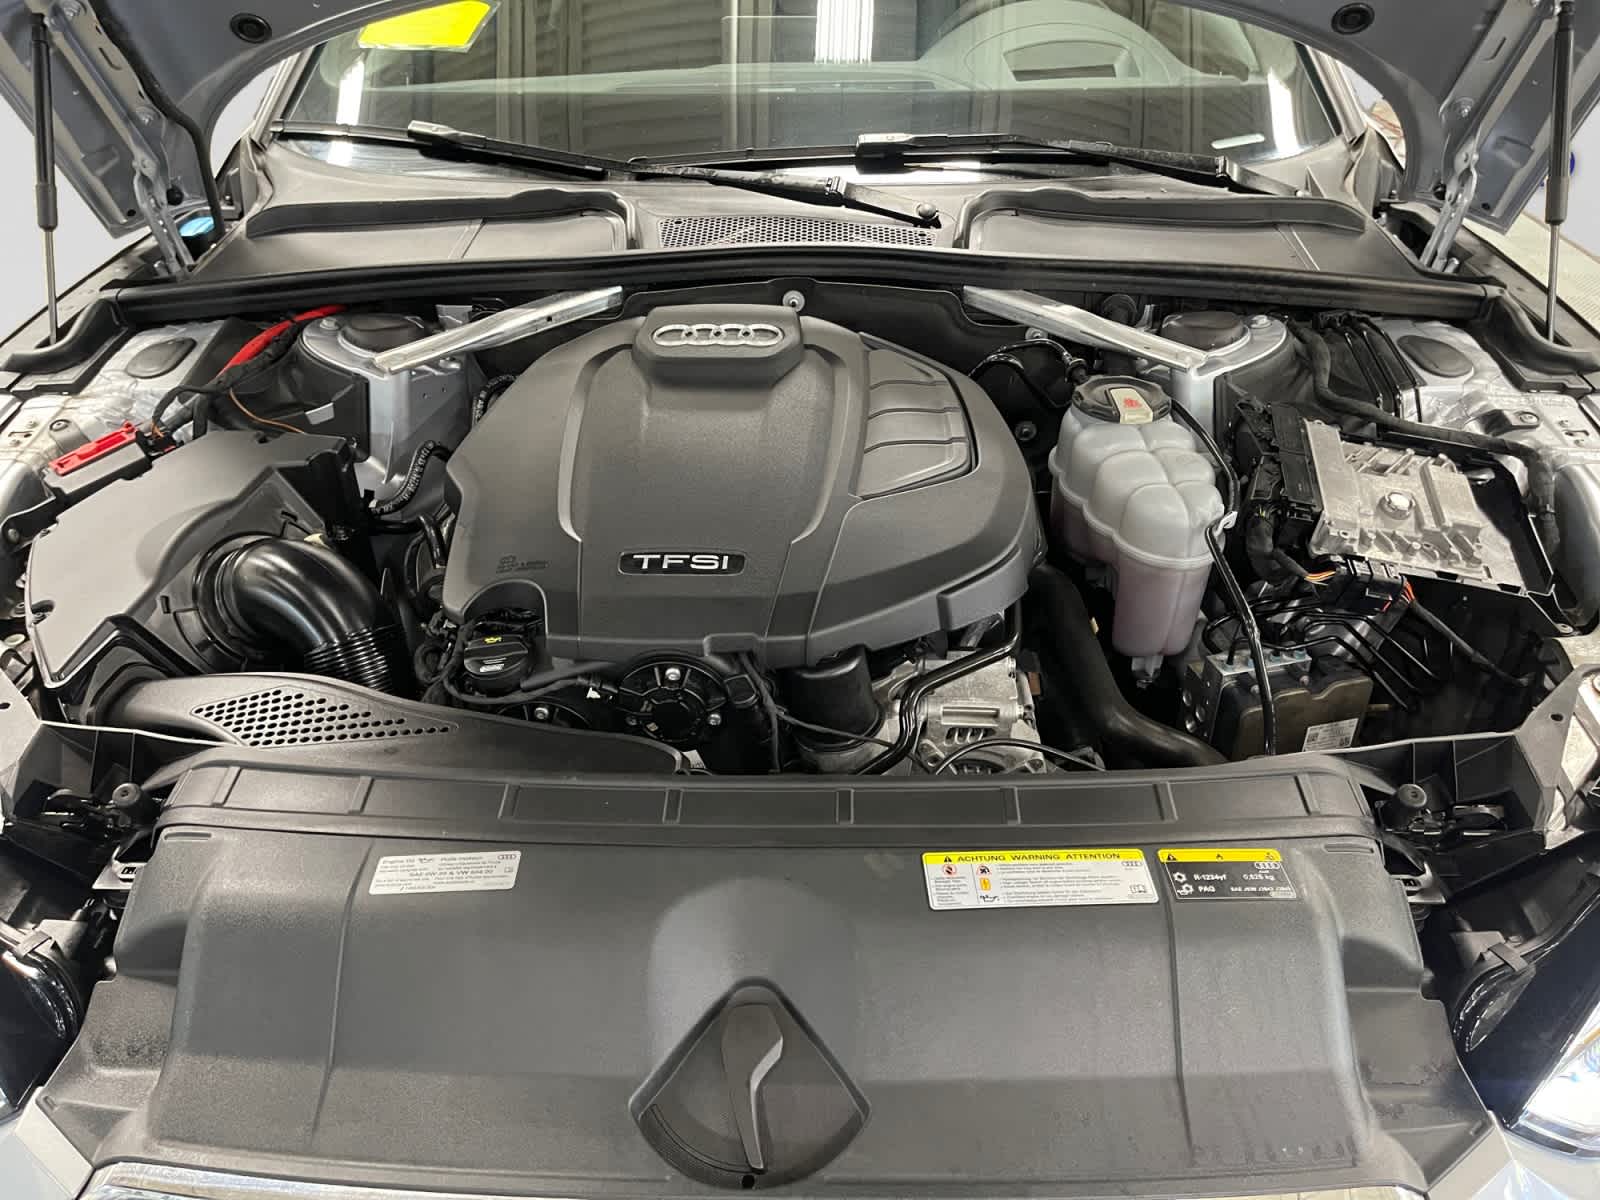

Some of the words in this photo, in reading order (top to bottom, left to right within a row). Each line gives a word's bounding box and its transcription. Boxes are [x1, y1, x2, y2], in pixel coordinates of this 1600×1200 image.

[632, 554, 729, 570] TFSI
[957, 854, 1006, 862] ACHTUNG
[1010, 853, 1060, 861] WARNING
[1066, 852, 1120, 860] ATTENTION
